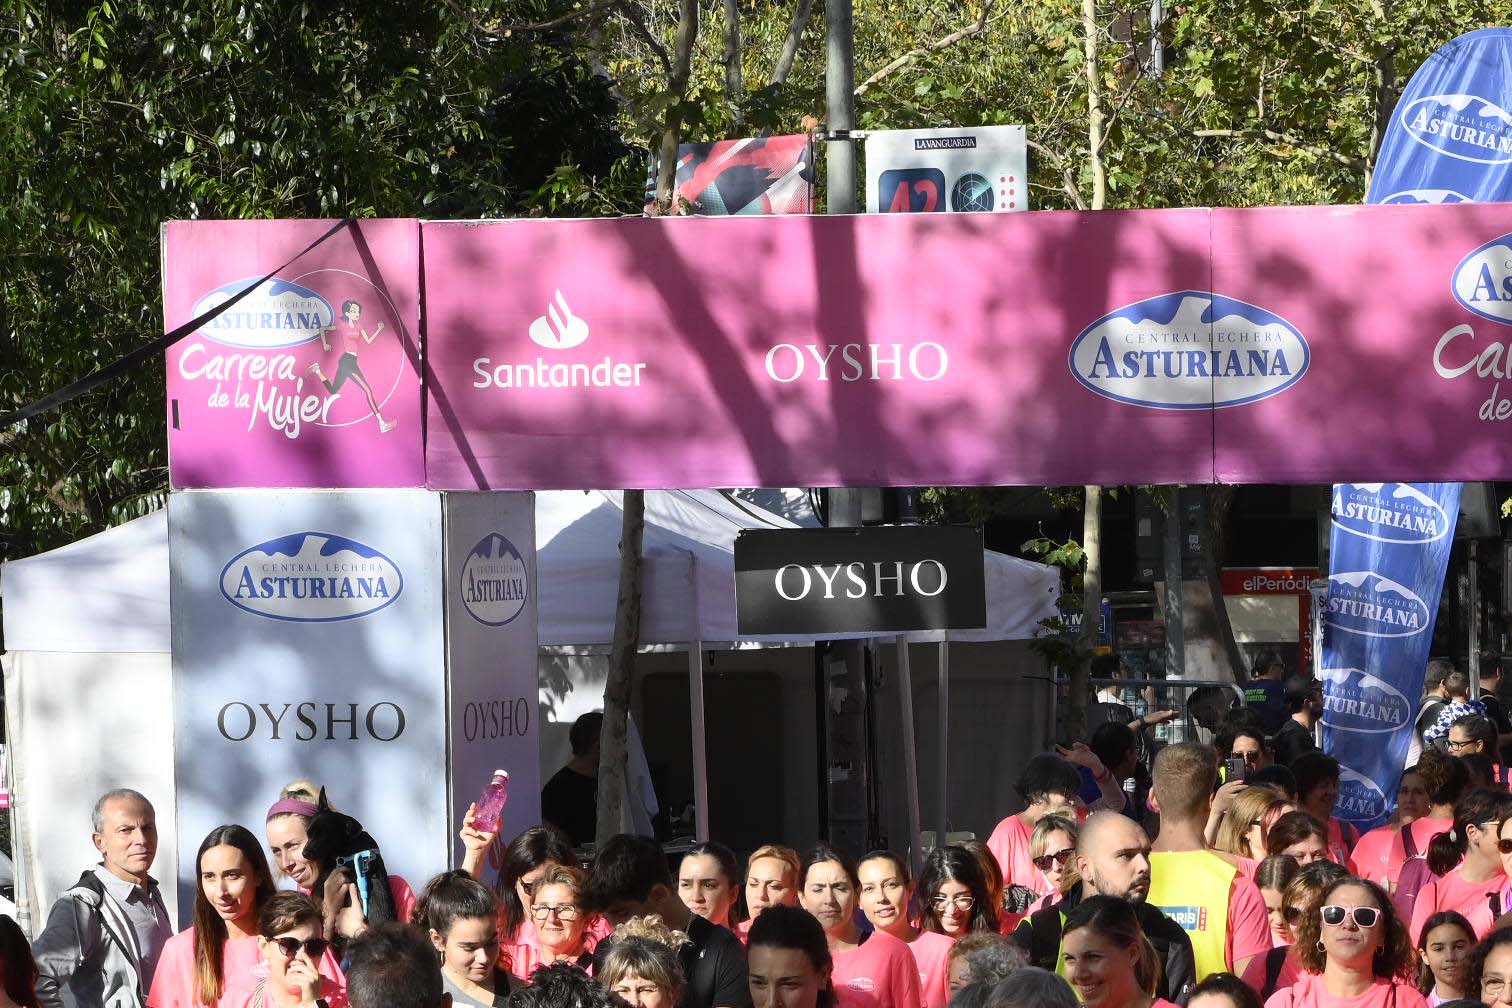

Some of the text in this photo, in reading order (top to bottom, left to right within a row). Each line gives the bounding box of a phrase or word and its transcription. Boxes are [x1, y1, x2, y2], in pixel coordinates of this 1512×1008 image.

[1088, 336, 1292, 379] ASTURIANA
[1125, 331, 1283, 343] CENTRAL LECHERA
[178, 343, 296, 381] Carrera
[473, 357, 646, 389] Santander
[764, 342, 949, 383] OYSHO
[207, 376, 342, 440] de la Mujer
[1478, 380, 1512, 421] de
[1331, 491, 1438, 536] ASTURIANA
[234, 566, 390, 599] ASTURIANA
[262, 563, 384, 572] CENTRAL LECHERA
[467, 568, 524, 603] ASTURIANA
[774, 559, 948, 600] OYSHO
[217, 700, 406, 742] OYSHO
[463, 697, 530, 742] OYSHO
